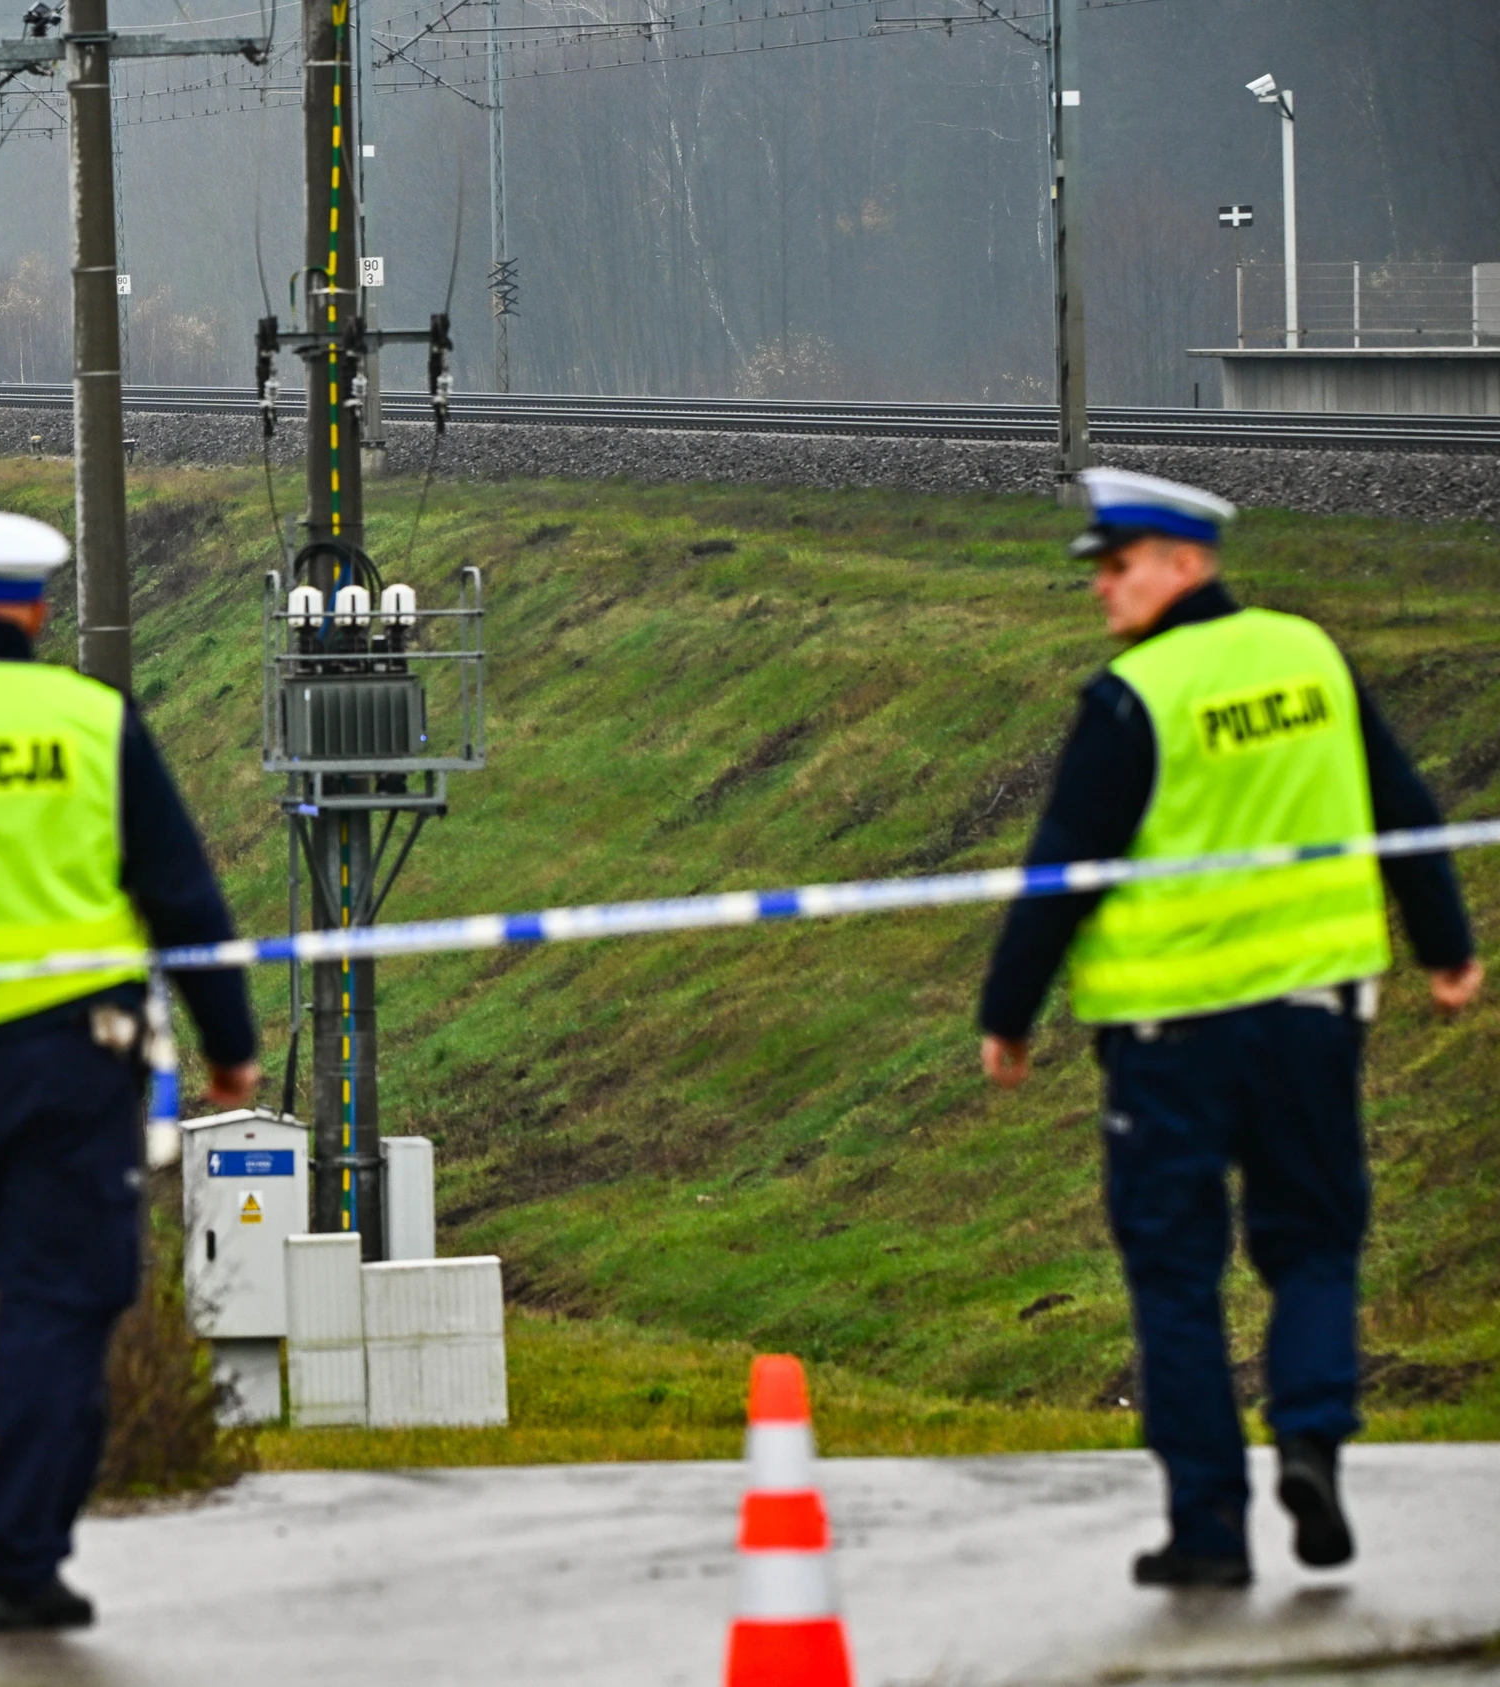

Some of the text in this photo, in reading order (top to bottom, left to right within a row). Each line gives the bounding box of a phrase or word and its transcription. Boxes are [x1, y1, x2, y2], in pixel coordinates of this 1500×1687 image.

[363, 259, 379, 271] 90
[117, 276, 128, 285] 90
[366, 273, 374, 284] 3
[119, 285, 125, 293] 4
[1202, 684, 1329, 753] POLICJA
